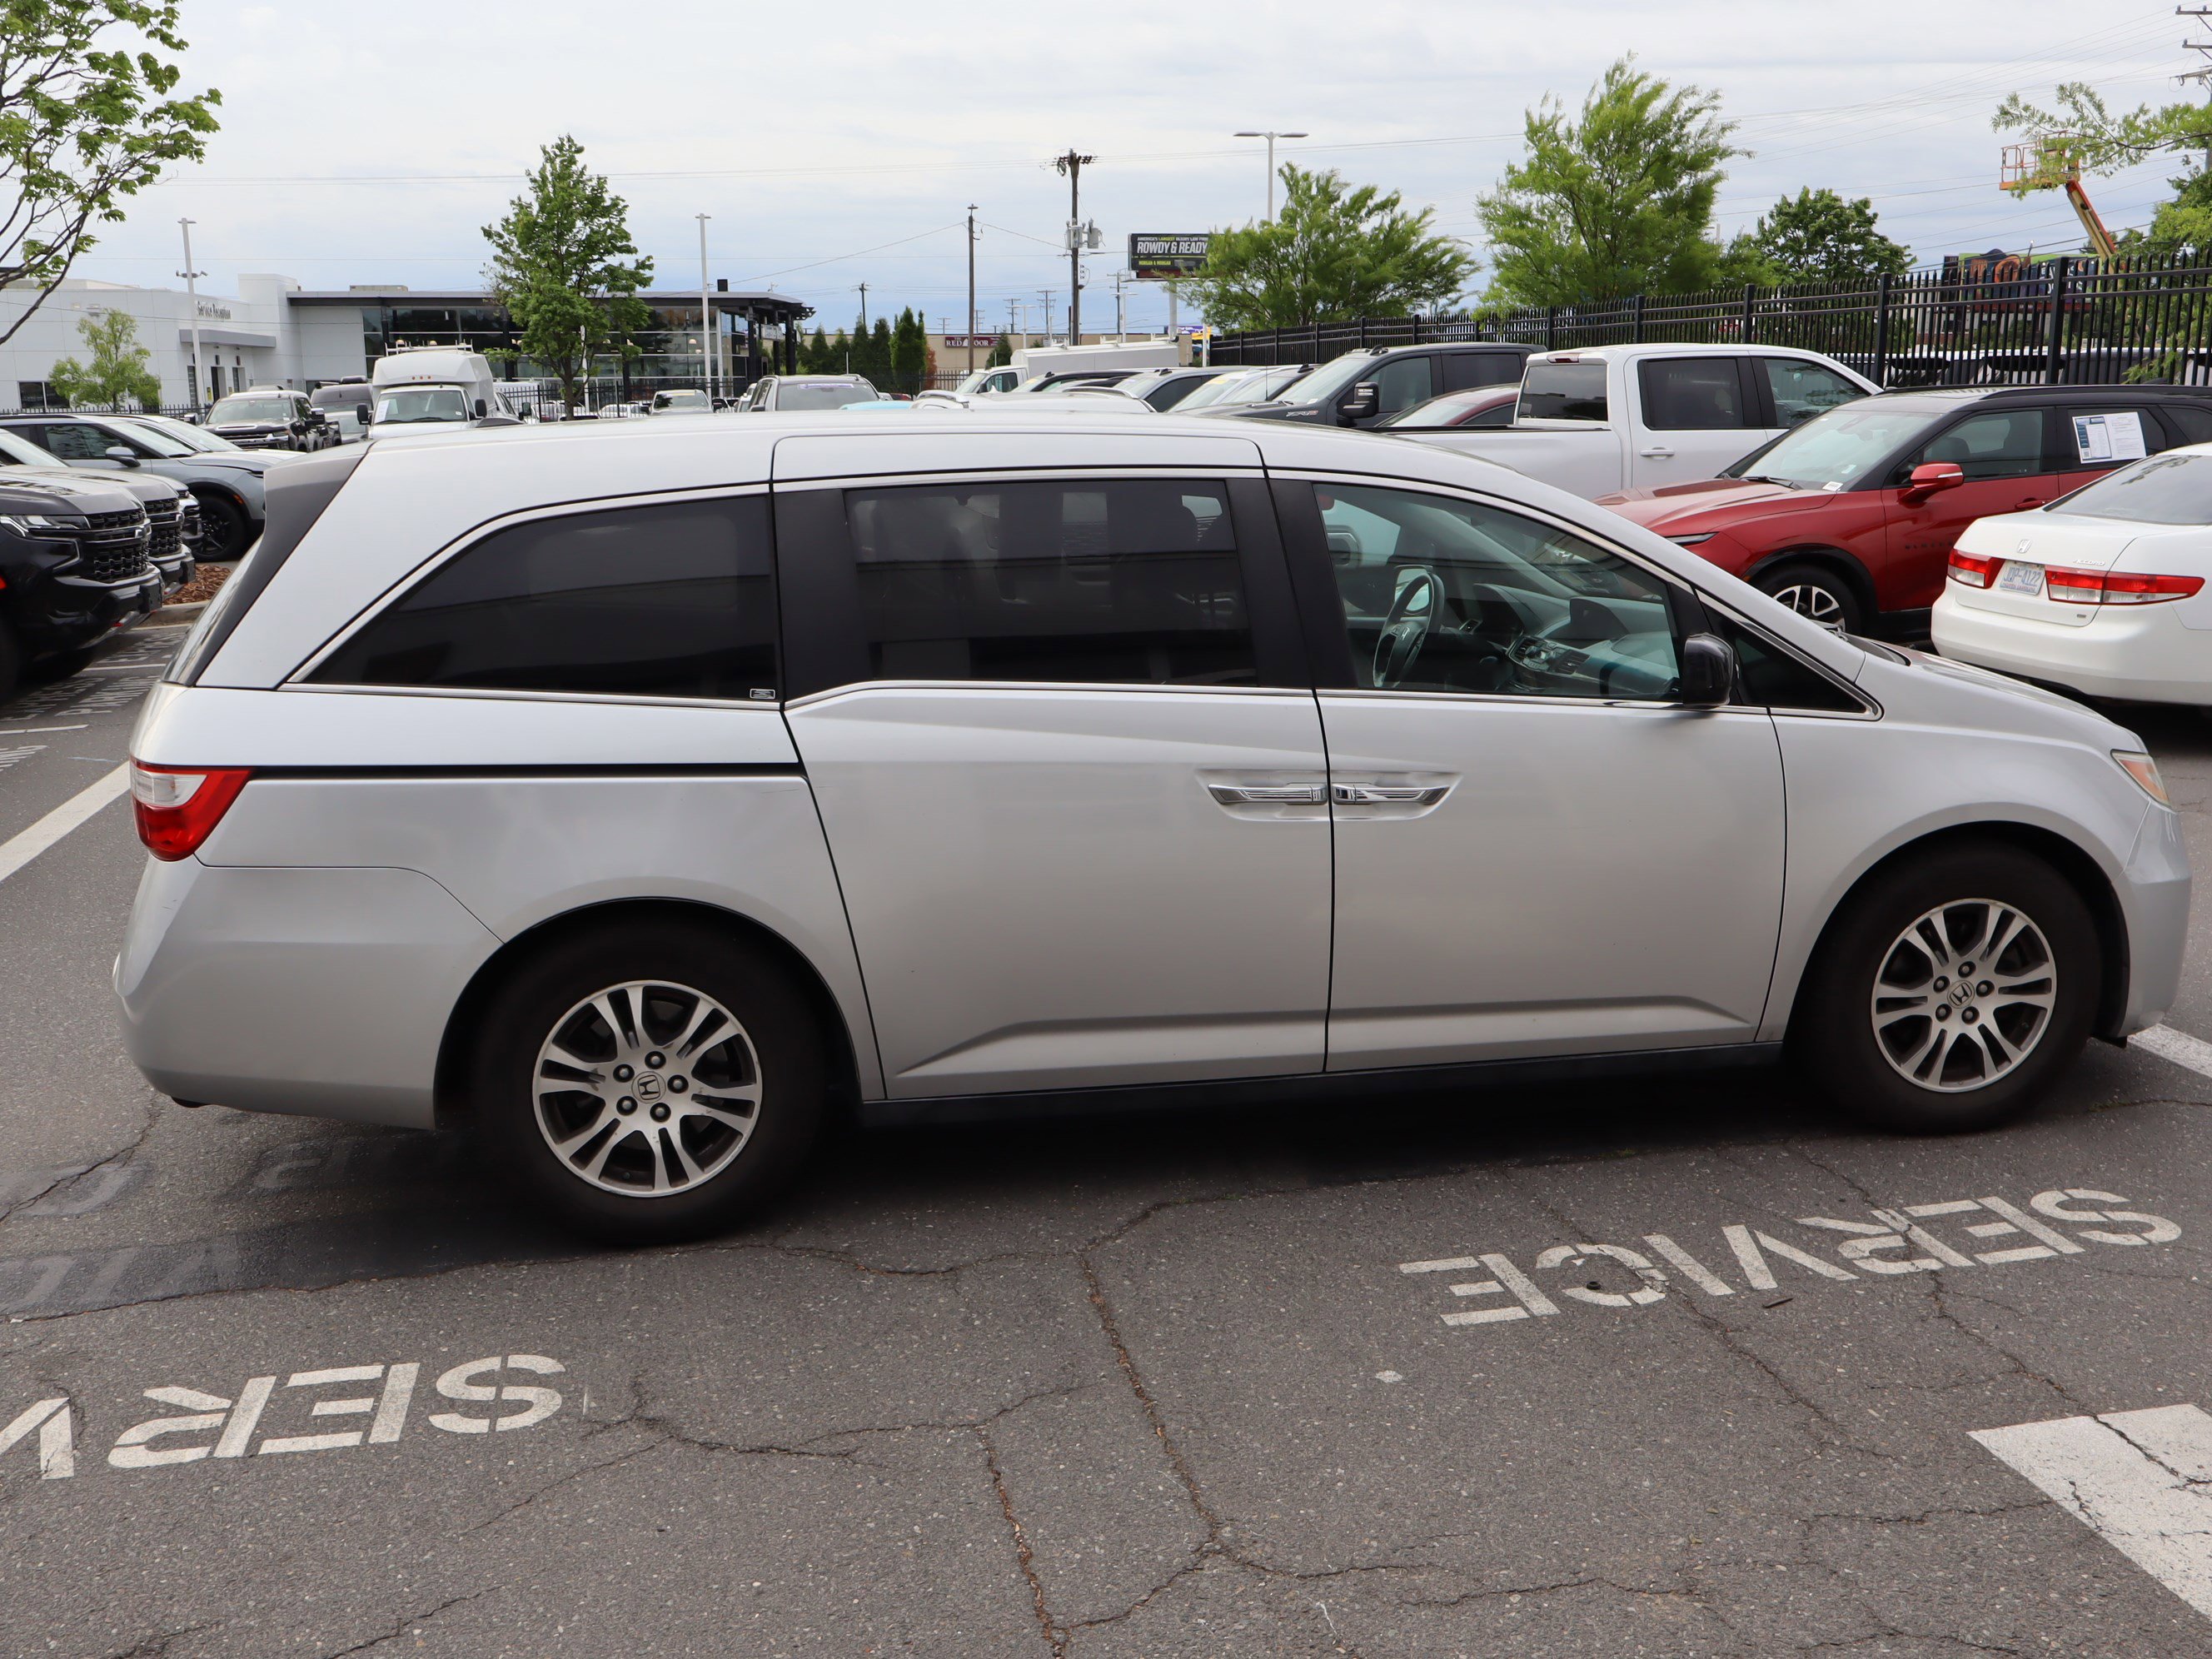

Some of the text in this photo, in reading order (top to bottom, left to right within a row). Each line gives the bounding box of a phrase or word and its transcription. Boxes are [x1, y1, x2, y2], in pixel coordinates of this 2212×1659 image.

[1137, 242, 1208, 254] ROWDY & READY
[1398, 1188, 2182, 1326] SERVICE
